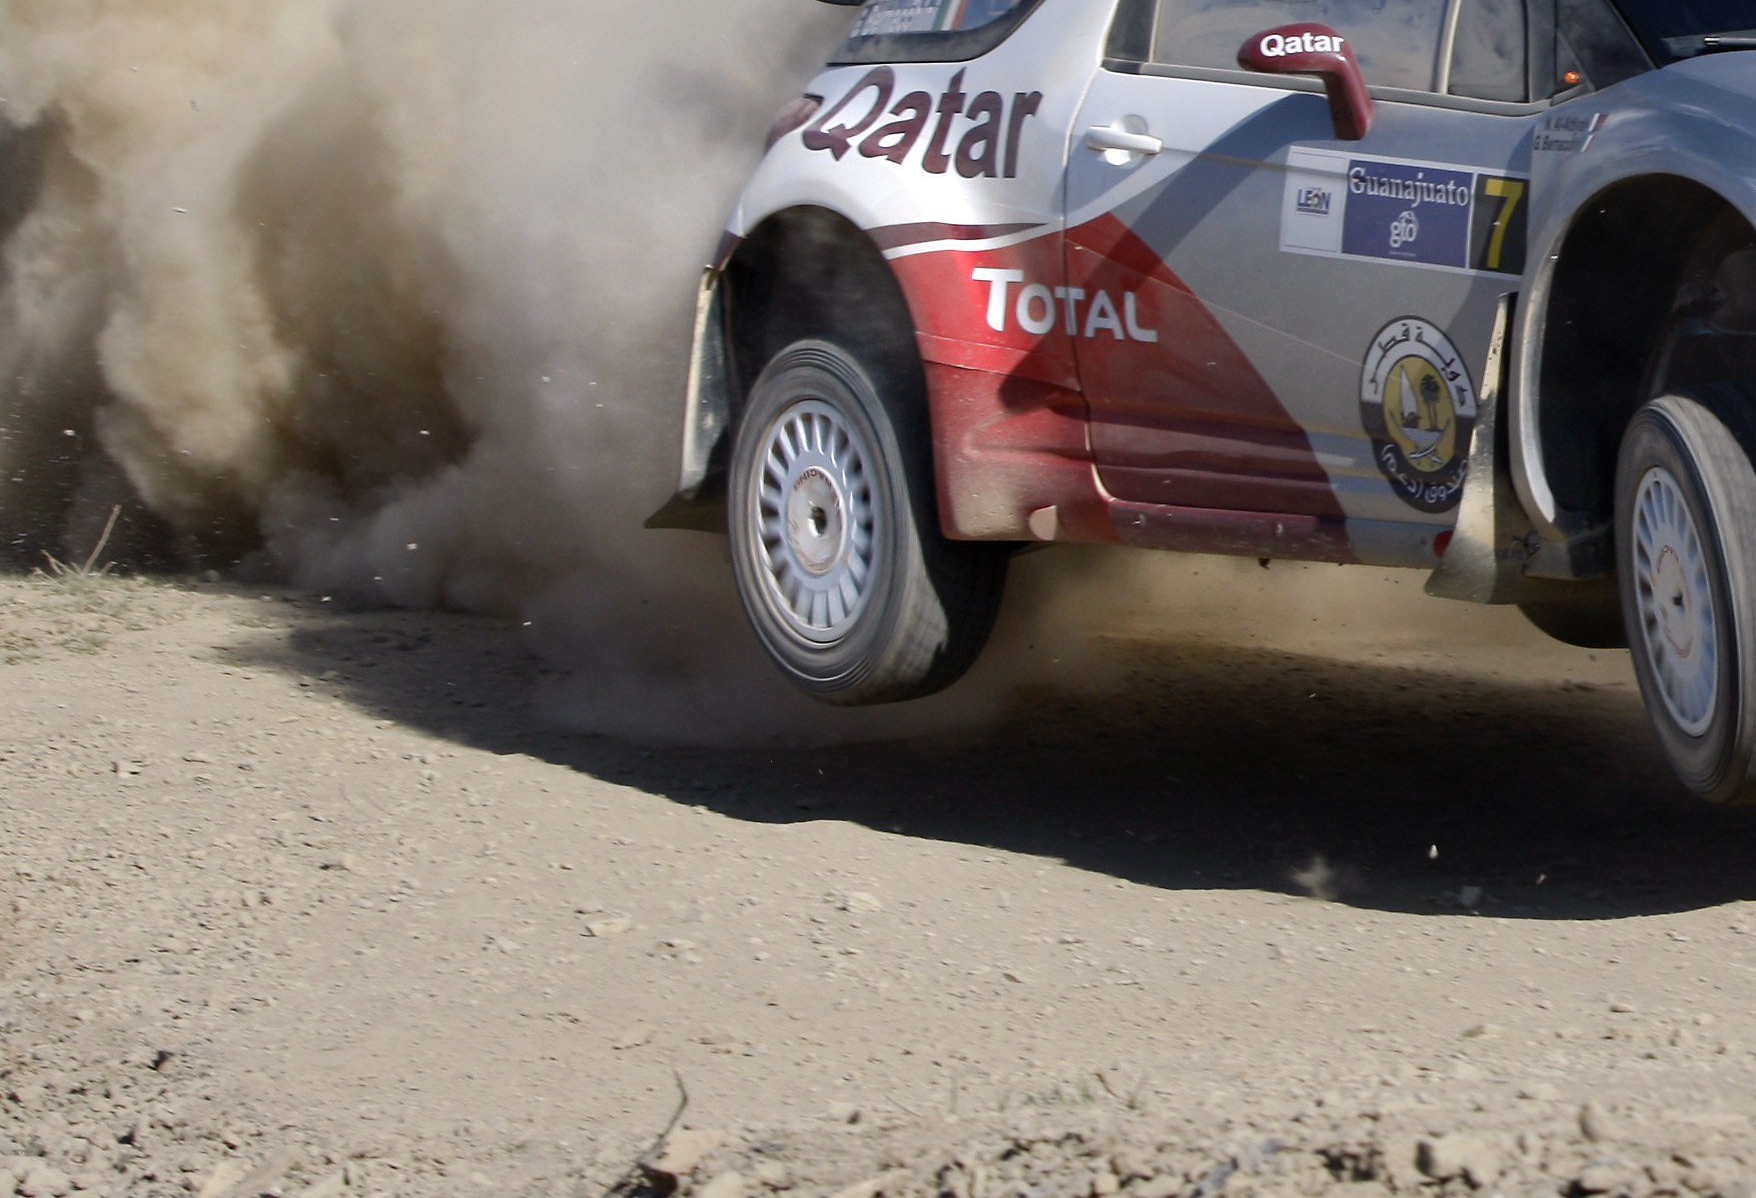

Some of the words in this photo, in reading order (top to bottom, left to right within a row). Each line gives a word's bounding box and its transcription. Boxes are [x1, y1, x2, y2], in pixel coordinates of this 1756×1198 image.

[1260, 32, 1345, 57] Qatar
[802, 65, 1044, 178] Qatar
[1350, 167, 1470, 208] Guanajuato
[1484, 178, 1525, 269] 7
[971, 267, 1158, 343] TOTAL
